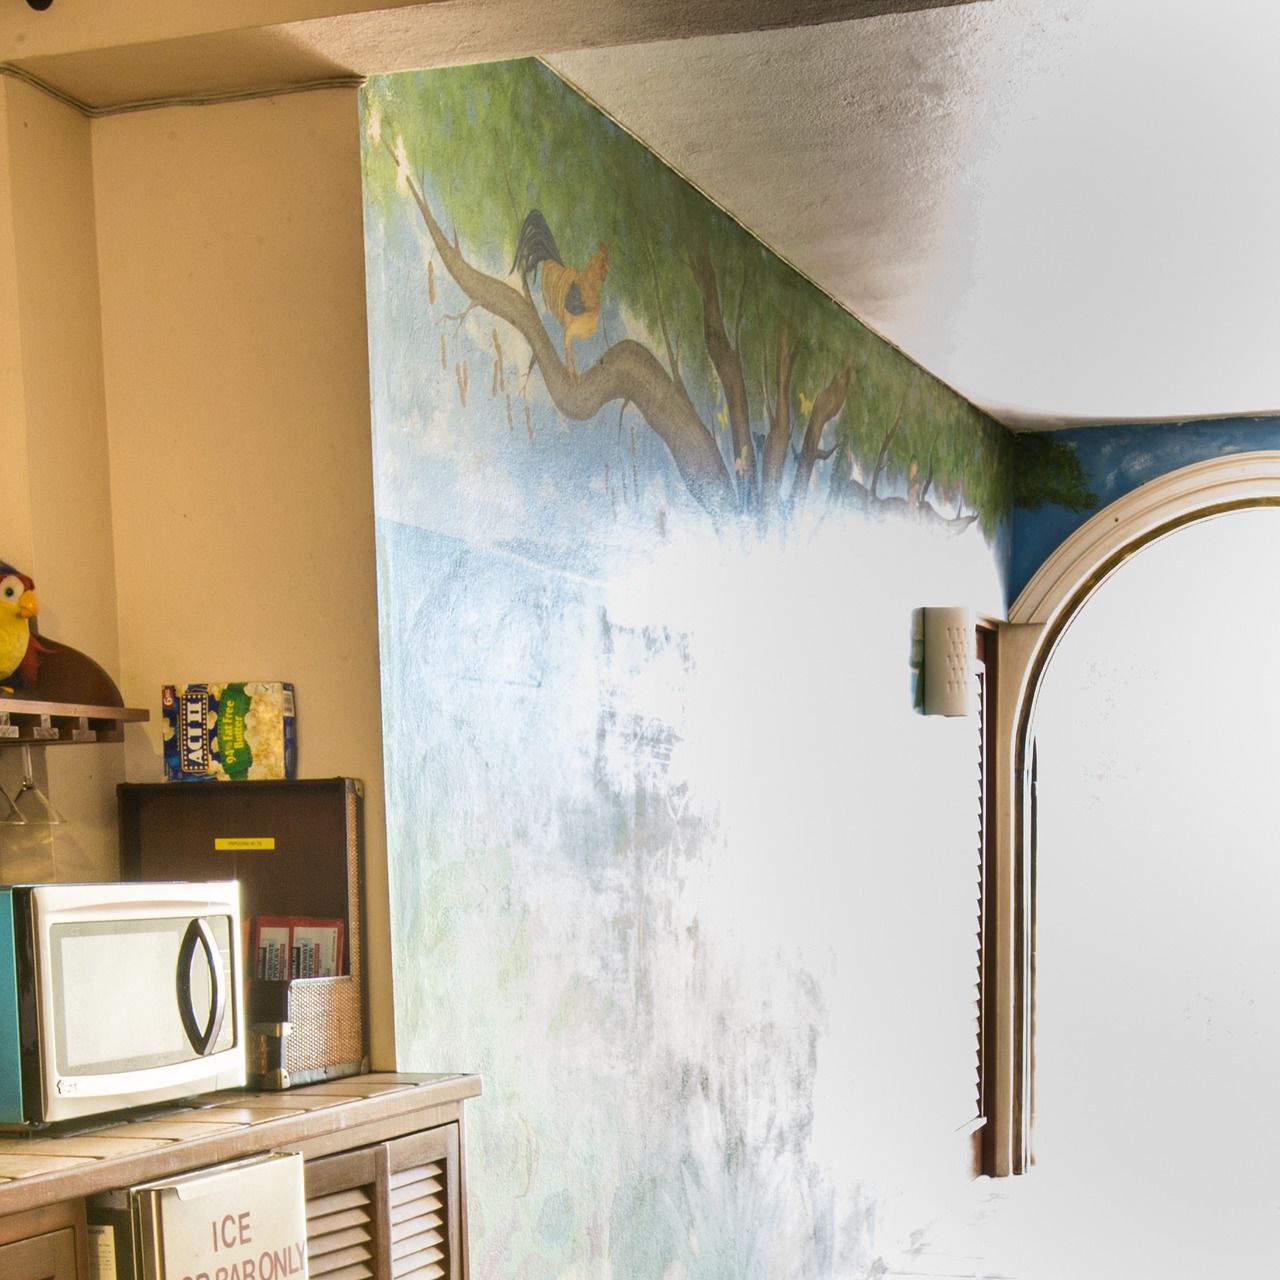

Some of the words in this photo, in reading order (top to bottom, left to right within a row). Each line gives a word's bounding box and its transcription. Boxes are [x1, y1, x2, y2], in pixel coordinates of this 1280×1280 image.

[187, 702, 202, 723] II
[223, 700, 234, 723] Free
[187, 728, 203, 764] ACT
[223, 723, 234, 742] Fat
[234, 716, 244, 749] Butter
[211, 1211, 252, 1252] ICE
